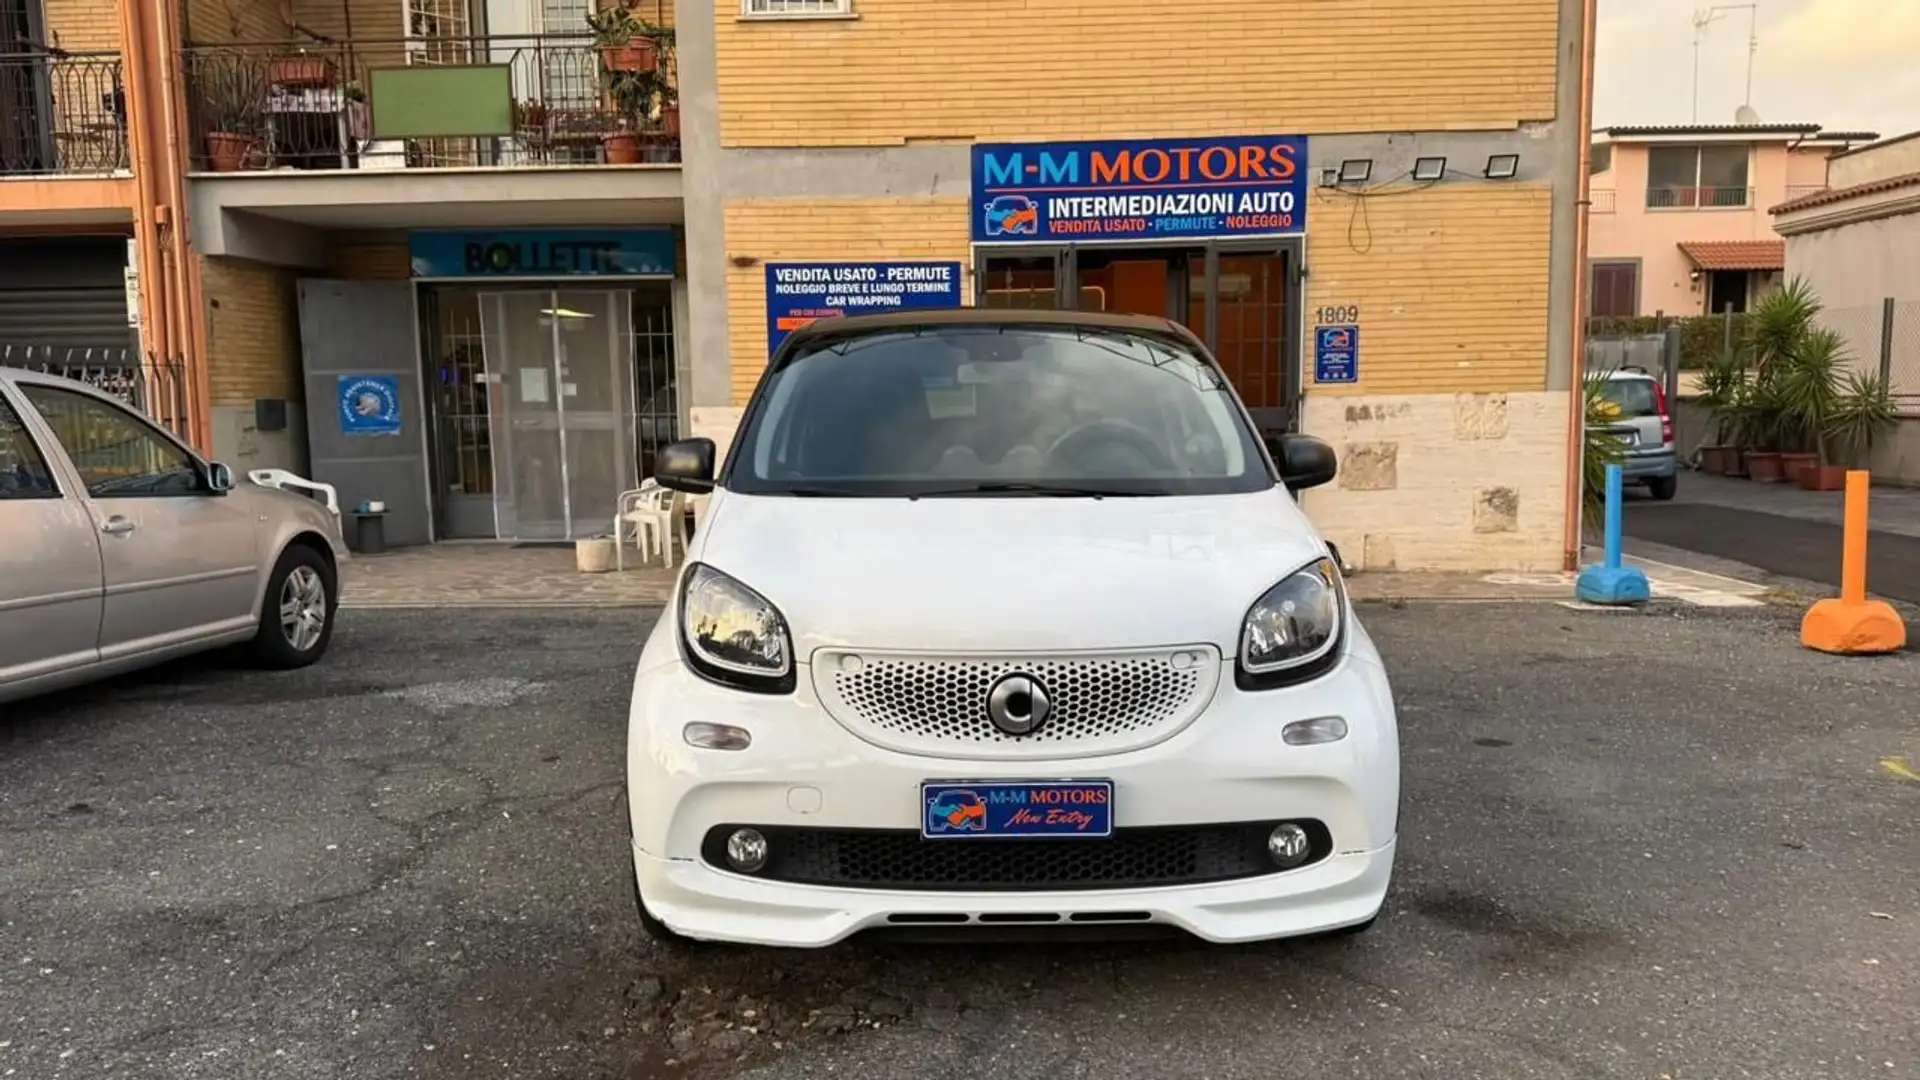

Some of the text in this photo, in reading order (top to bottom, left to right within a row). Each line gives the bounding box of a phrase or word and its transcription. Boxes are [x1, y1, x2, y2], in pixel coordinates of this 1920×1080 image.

[984, 144, 1297, 186] M-M MOTORS
[1048, 191, 1295, 219] INTERMEDIAZIONI AUTO
[1048, 219, 1102, 234] VENDITA
[1104, 217, 1146, 232] USATO
[1155, 216, 1217, 232] PERMUTE
[1226, 214, 1292, 229] NOLEGGIO
[465, 241, 622, 274] BOLLETTE
[776, 267, 831, 281] VENDITA
[834, 267, 876, 281] USATO
[888, 266, 951, 280] PERMUTE
[776, 281, 951, 295] NOLEGGIO BREVE E LUNGO TERMINE
[825, 295, 901, 307] CAR WRAPPING
[1316, 305, 1358, 324] 1809
[989, 789, 1107, 805] M-M MOTORS
[1004, 807, 1094, 830] New Entry
